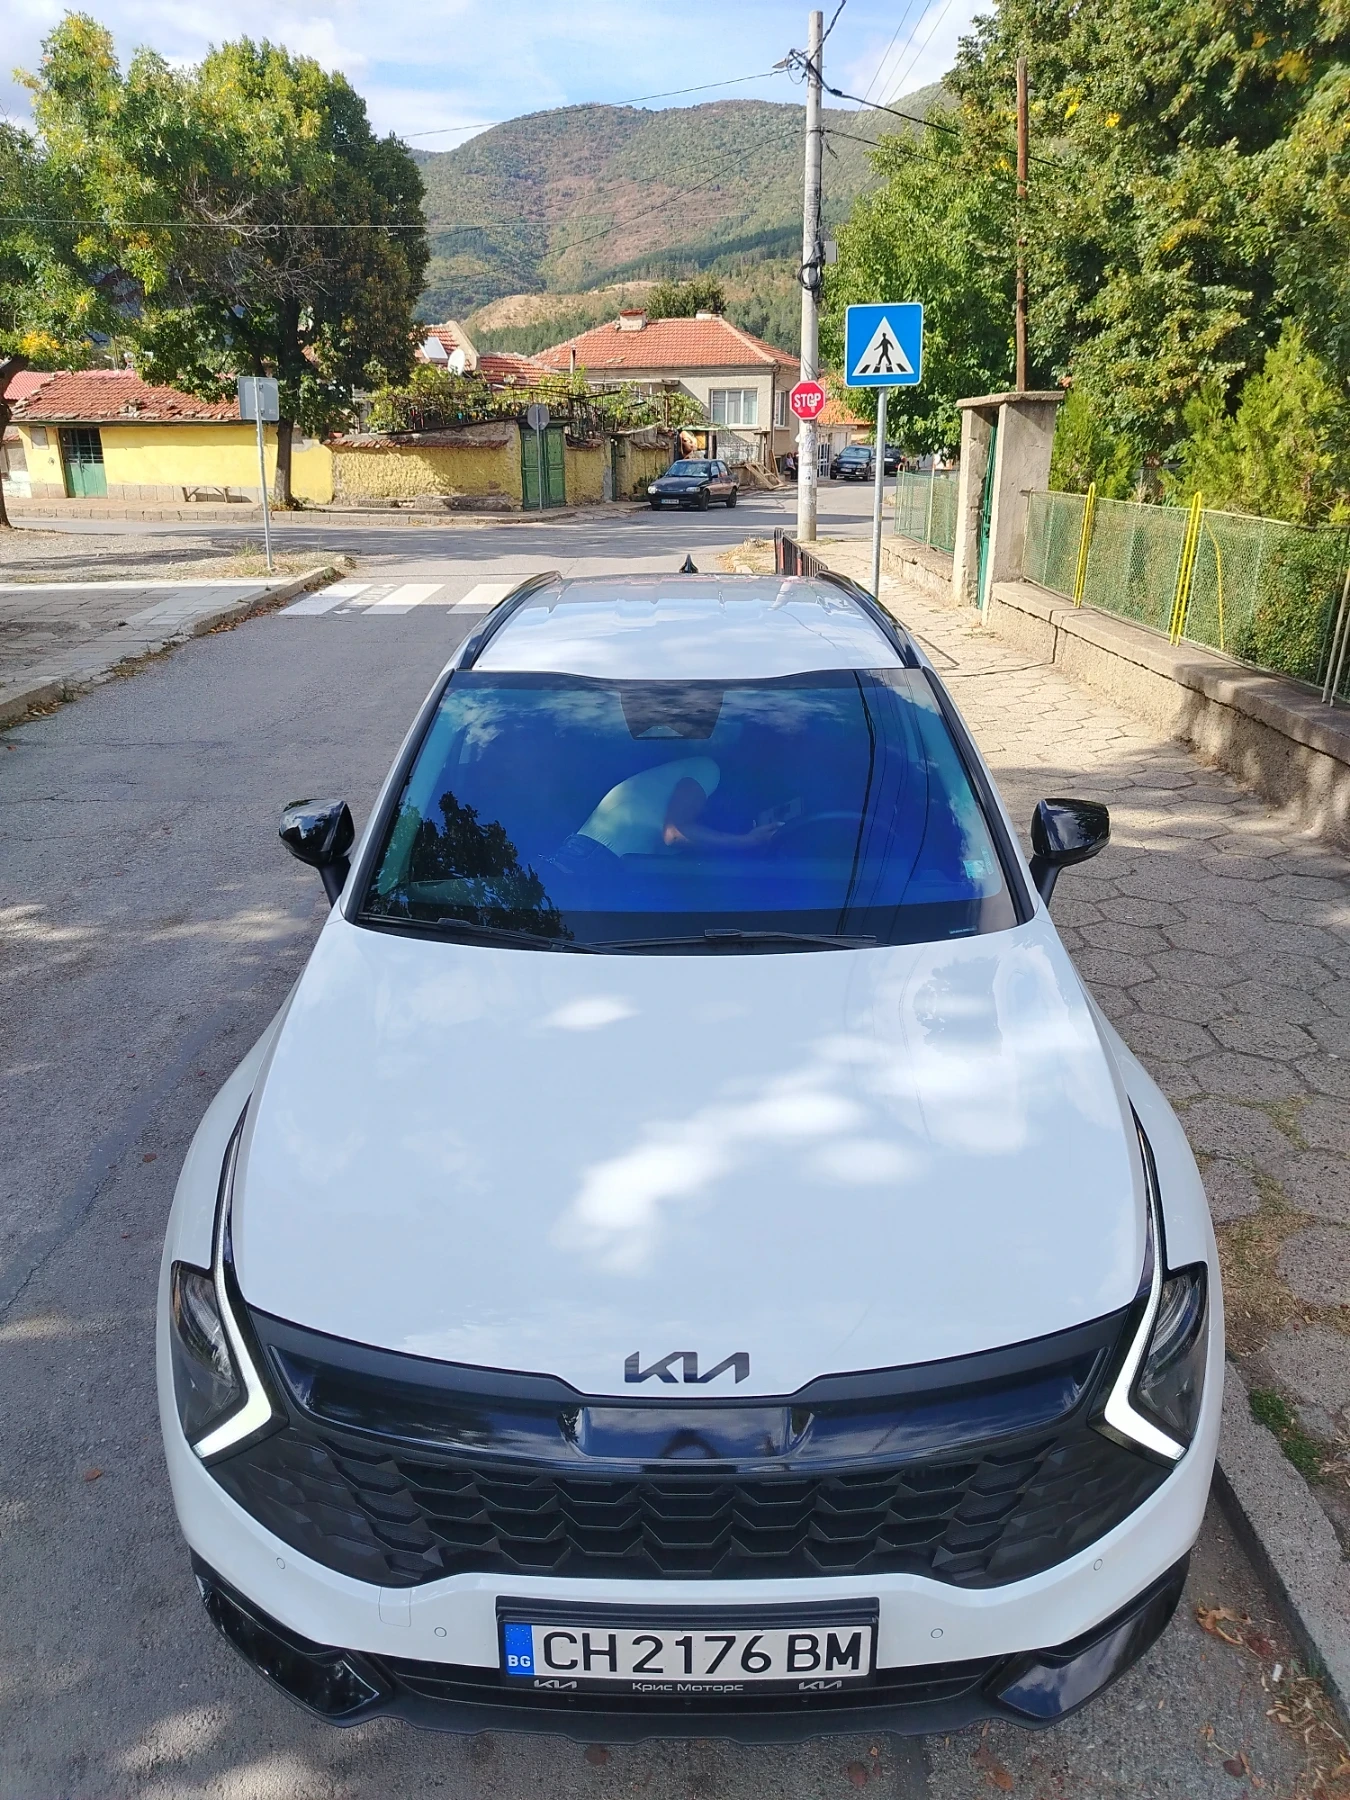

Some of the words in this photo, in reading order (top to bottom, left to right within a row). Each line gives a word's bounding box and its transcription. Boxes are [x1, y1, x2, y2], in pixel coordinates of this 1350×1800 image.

[794, 393, 821, 407] STOP
[624, 1351, 749, 1384] KIA
[543, 1631, 617, 1672] CH
[632, 1634, 772, 1674] 2176
[787, 1632, 862, 1672] BM
[508, 1655, 531, 1667] BG
[533, 1679, 577, 1689] KIA
[632, 1682, 673, 1693] Крис
[677, 1683, 744, 1694] Моторс
[798, 1680, 842, 1690] KIA
